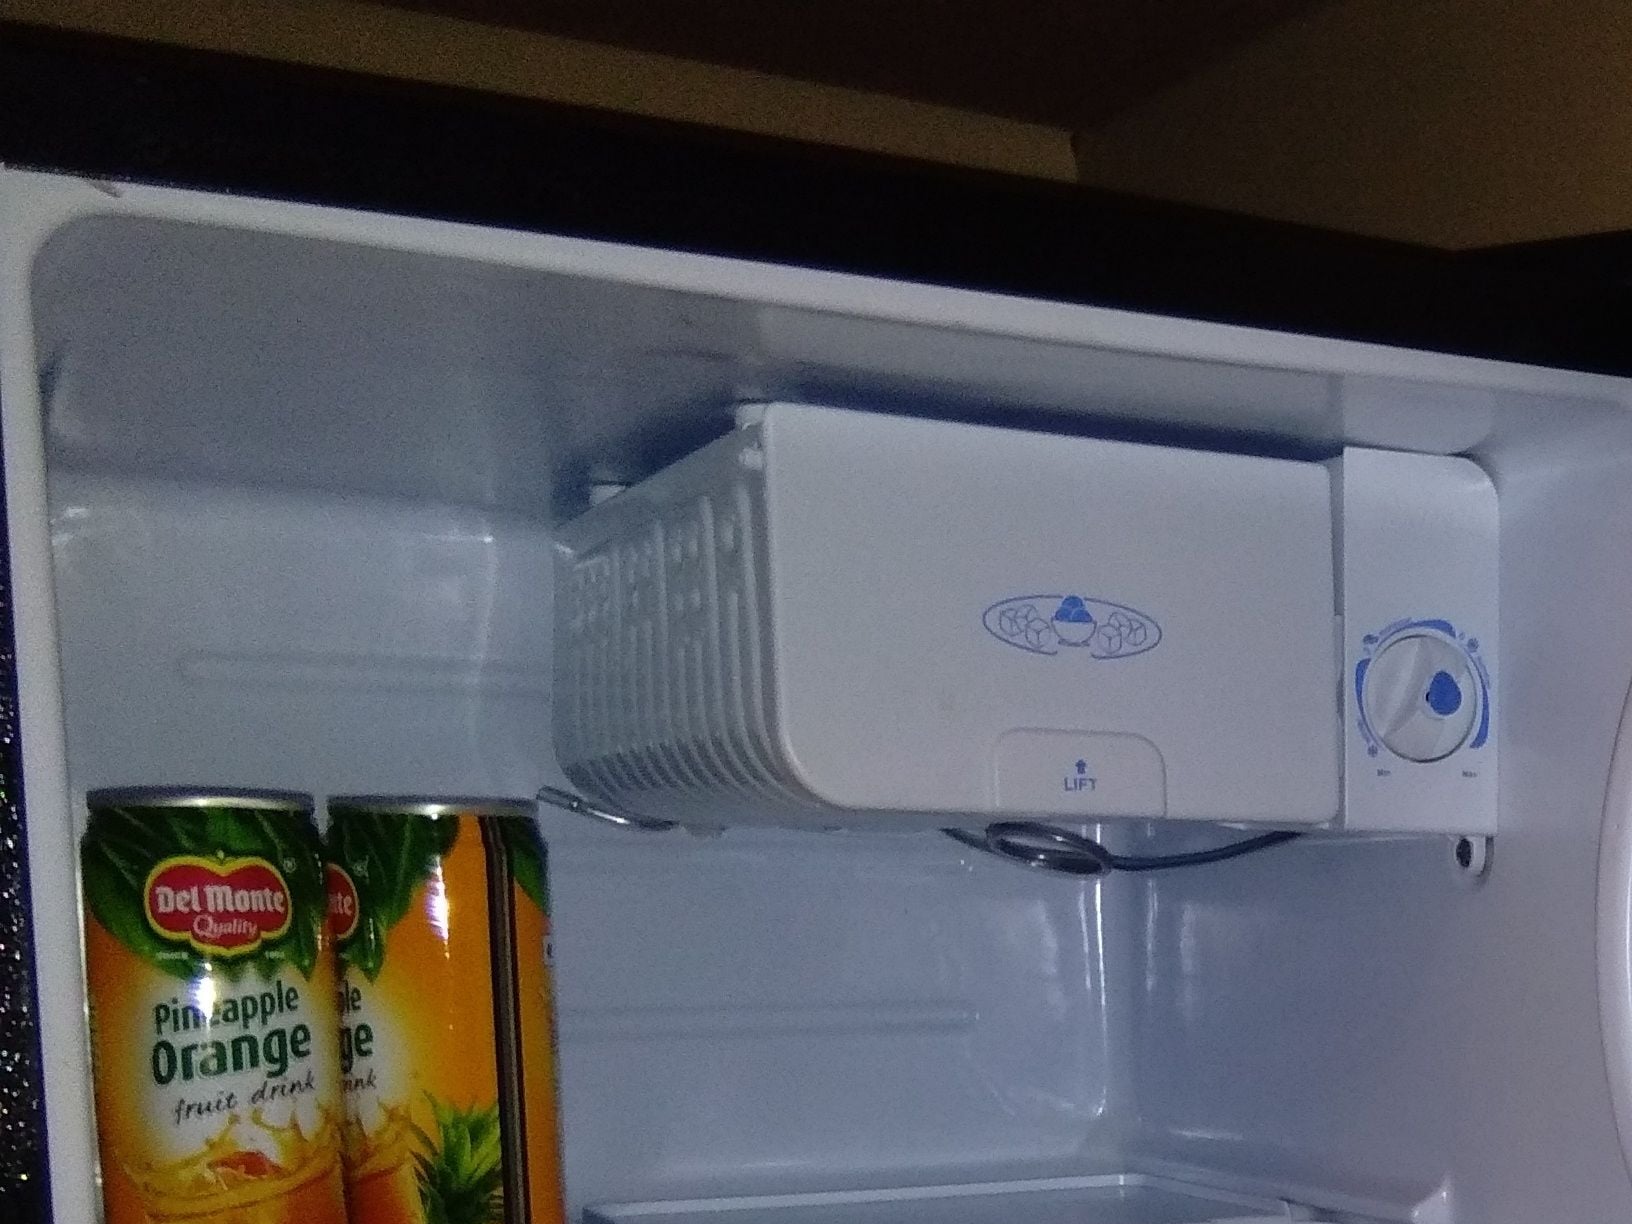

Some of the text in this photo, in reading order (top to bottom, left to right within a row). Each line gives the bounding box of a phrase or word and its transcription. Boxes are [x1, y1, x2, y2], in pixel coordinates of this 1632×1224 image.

[1064, 777, 1097, 791] LIFT
[156, 884, 286, 914] Del Monte
[192, 914, 258, 938] Quality
[154, 979, 300, 1036] Pinapple
[152, 1022, 312, 1085] Orange
[174, 1091, 238, 1125] fruit
[250, 1070, 317, 1105] drink
